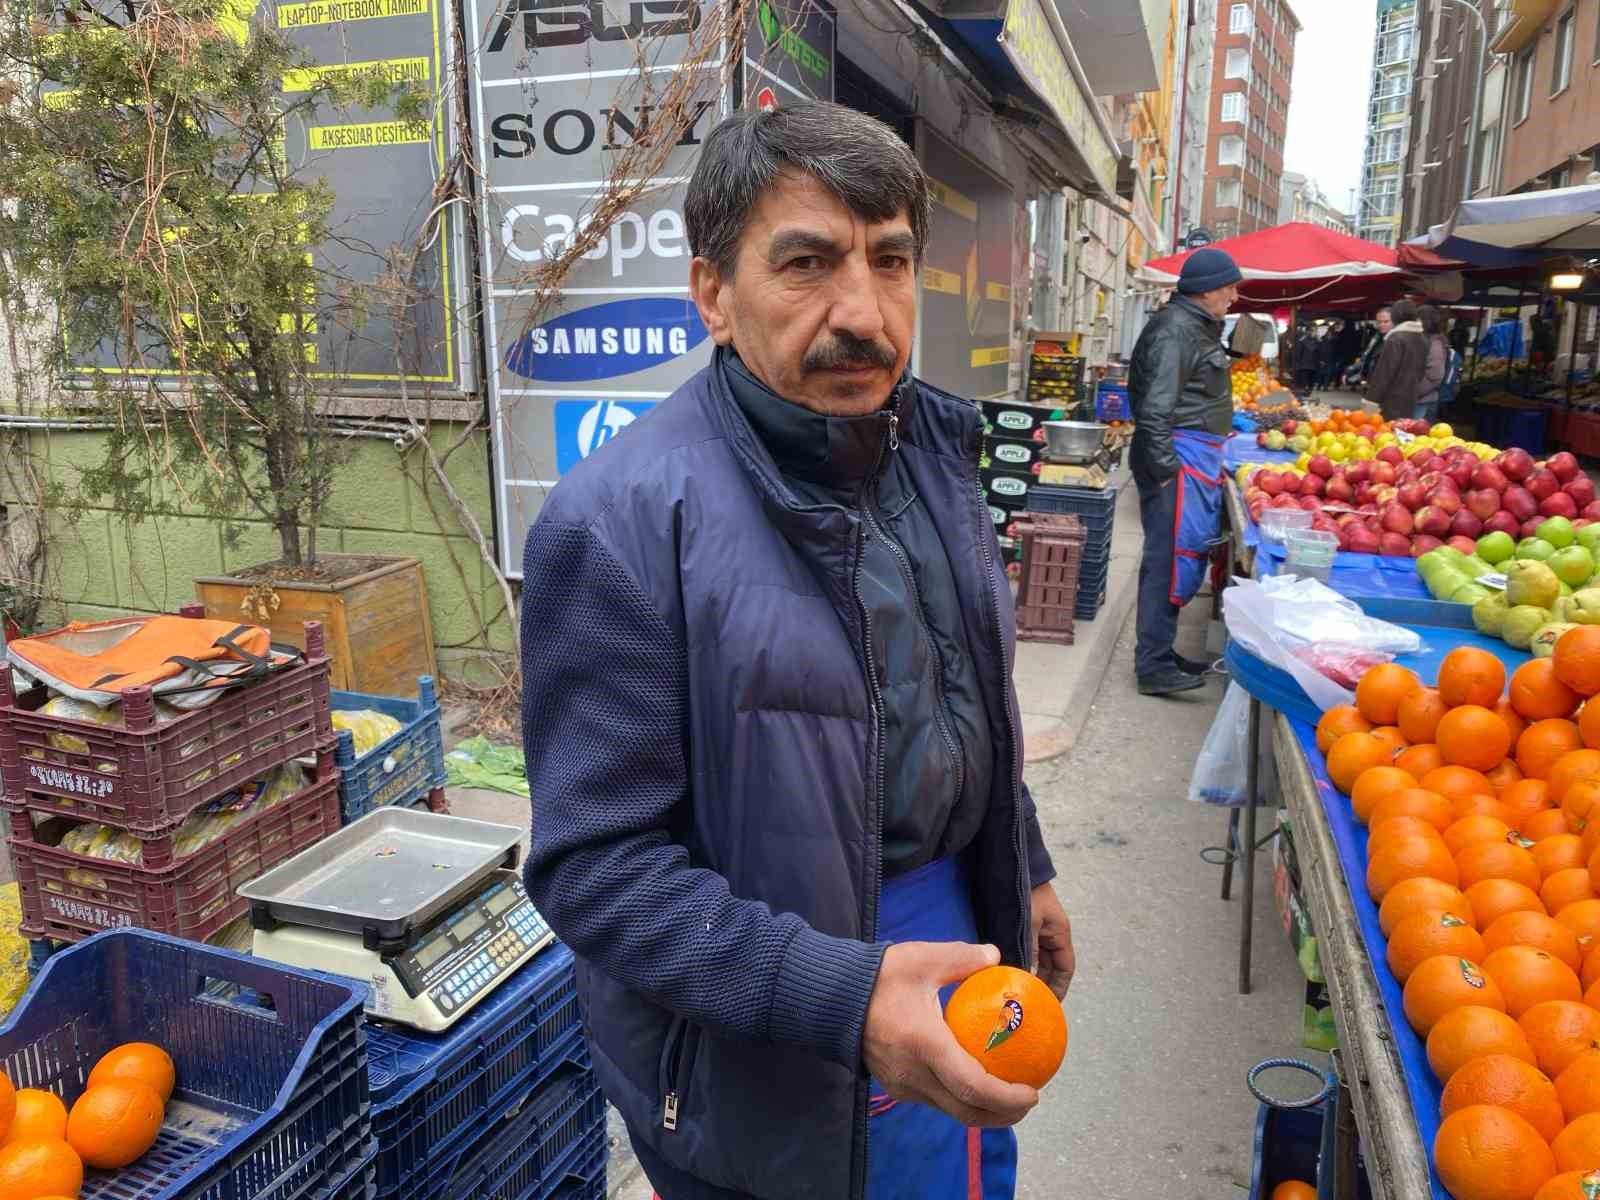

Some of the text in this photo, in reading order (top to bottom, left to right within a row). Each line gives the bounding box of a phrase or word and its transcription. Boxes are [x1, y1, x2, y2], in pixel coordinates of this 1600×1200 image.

[321, 126, 374, 147] AKSESUAR
[490, 100, 717, 159] SONY
[502, 204, 693, 277] Caspe
[531, 327, 688, 355] SAMSUNG
[1003, 414, 1029, 426] APPLE
[1000, 448, 1026, 459] APPLE
[996, 481, 1022, 492] APPLE
